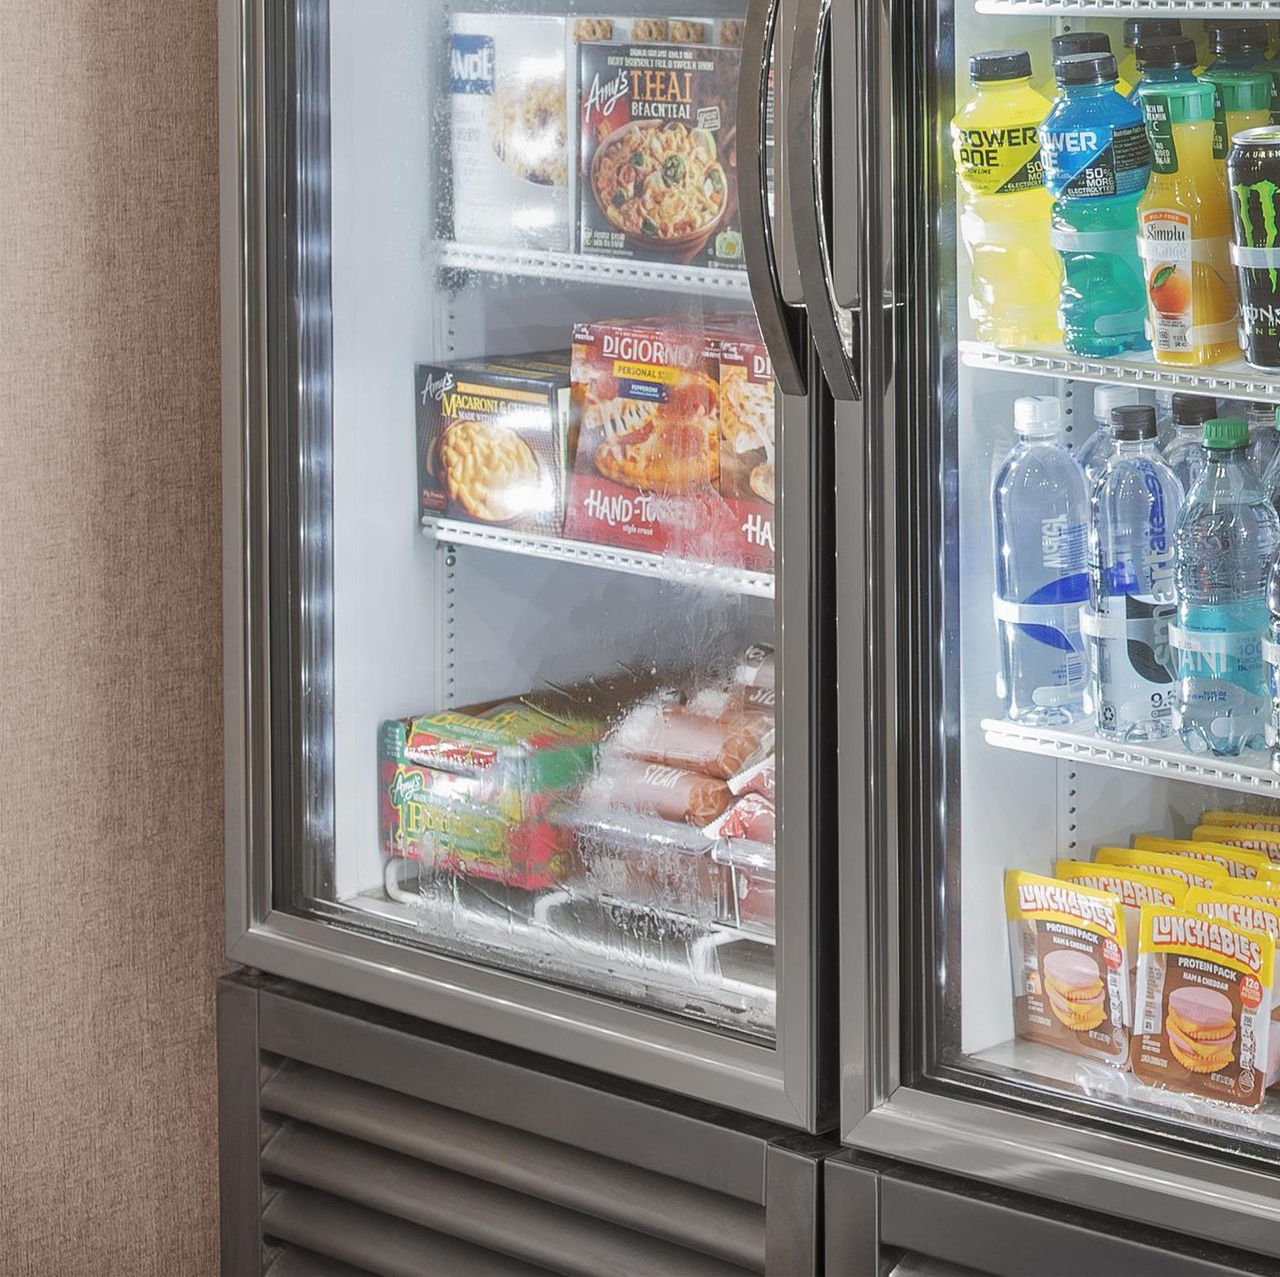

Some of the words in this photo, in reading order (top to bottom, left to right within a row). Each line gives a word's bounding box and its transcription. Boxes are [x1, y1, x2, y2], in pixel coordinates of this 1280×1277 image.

[584, 69, 629, 123] Amy's
[960, 128, 1037, 146] POWER
[960, 148, 999, 167] ADE
[1086, 168, 1112, 179] 50%
[1087, 177, 1113, 187] MORE
[1069, 187, 1115, 195] ELECTROLYTES
[1147, 225, 1185, 241] Simply
[617, 364, 655, 379] PERSONAL
[422, 373, 455, 404] Amy's
[441, 393, 498, 417] MACARONI
[1019, 885, 1116, 933] LUNCHABLES
[1046, 923, 1076, 939] PROTEIN
[1077, 931, 1098, 943] PACK
[1153, 917, 1261, 972] LUNCHABLES
[1179, 958, 1211, 974] PROTEIN
[1213, 966, 1237, 980] PACK
